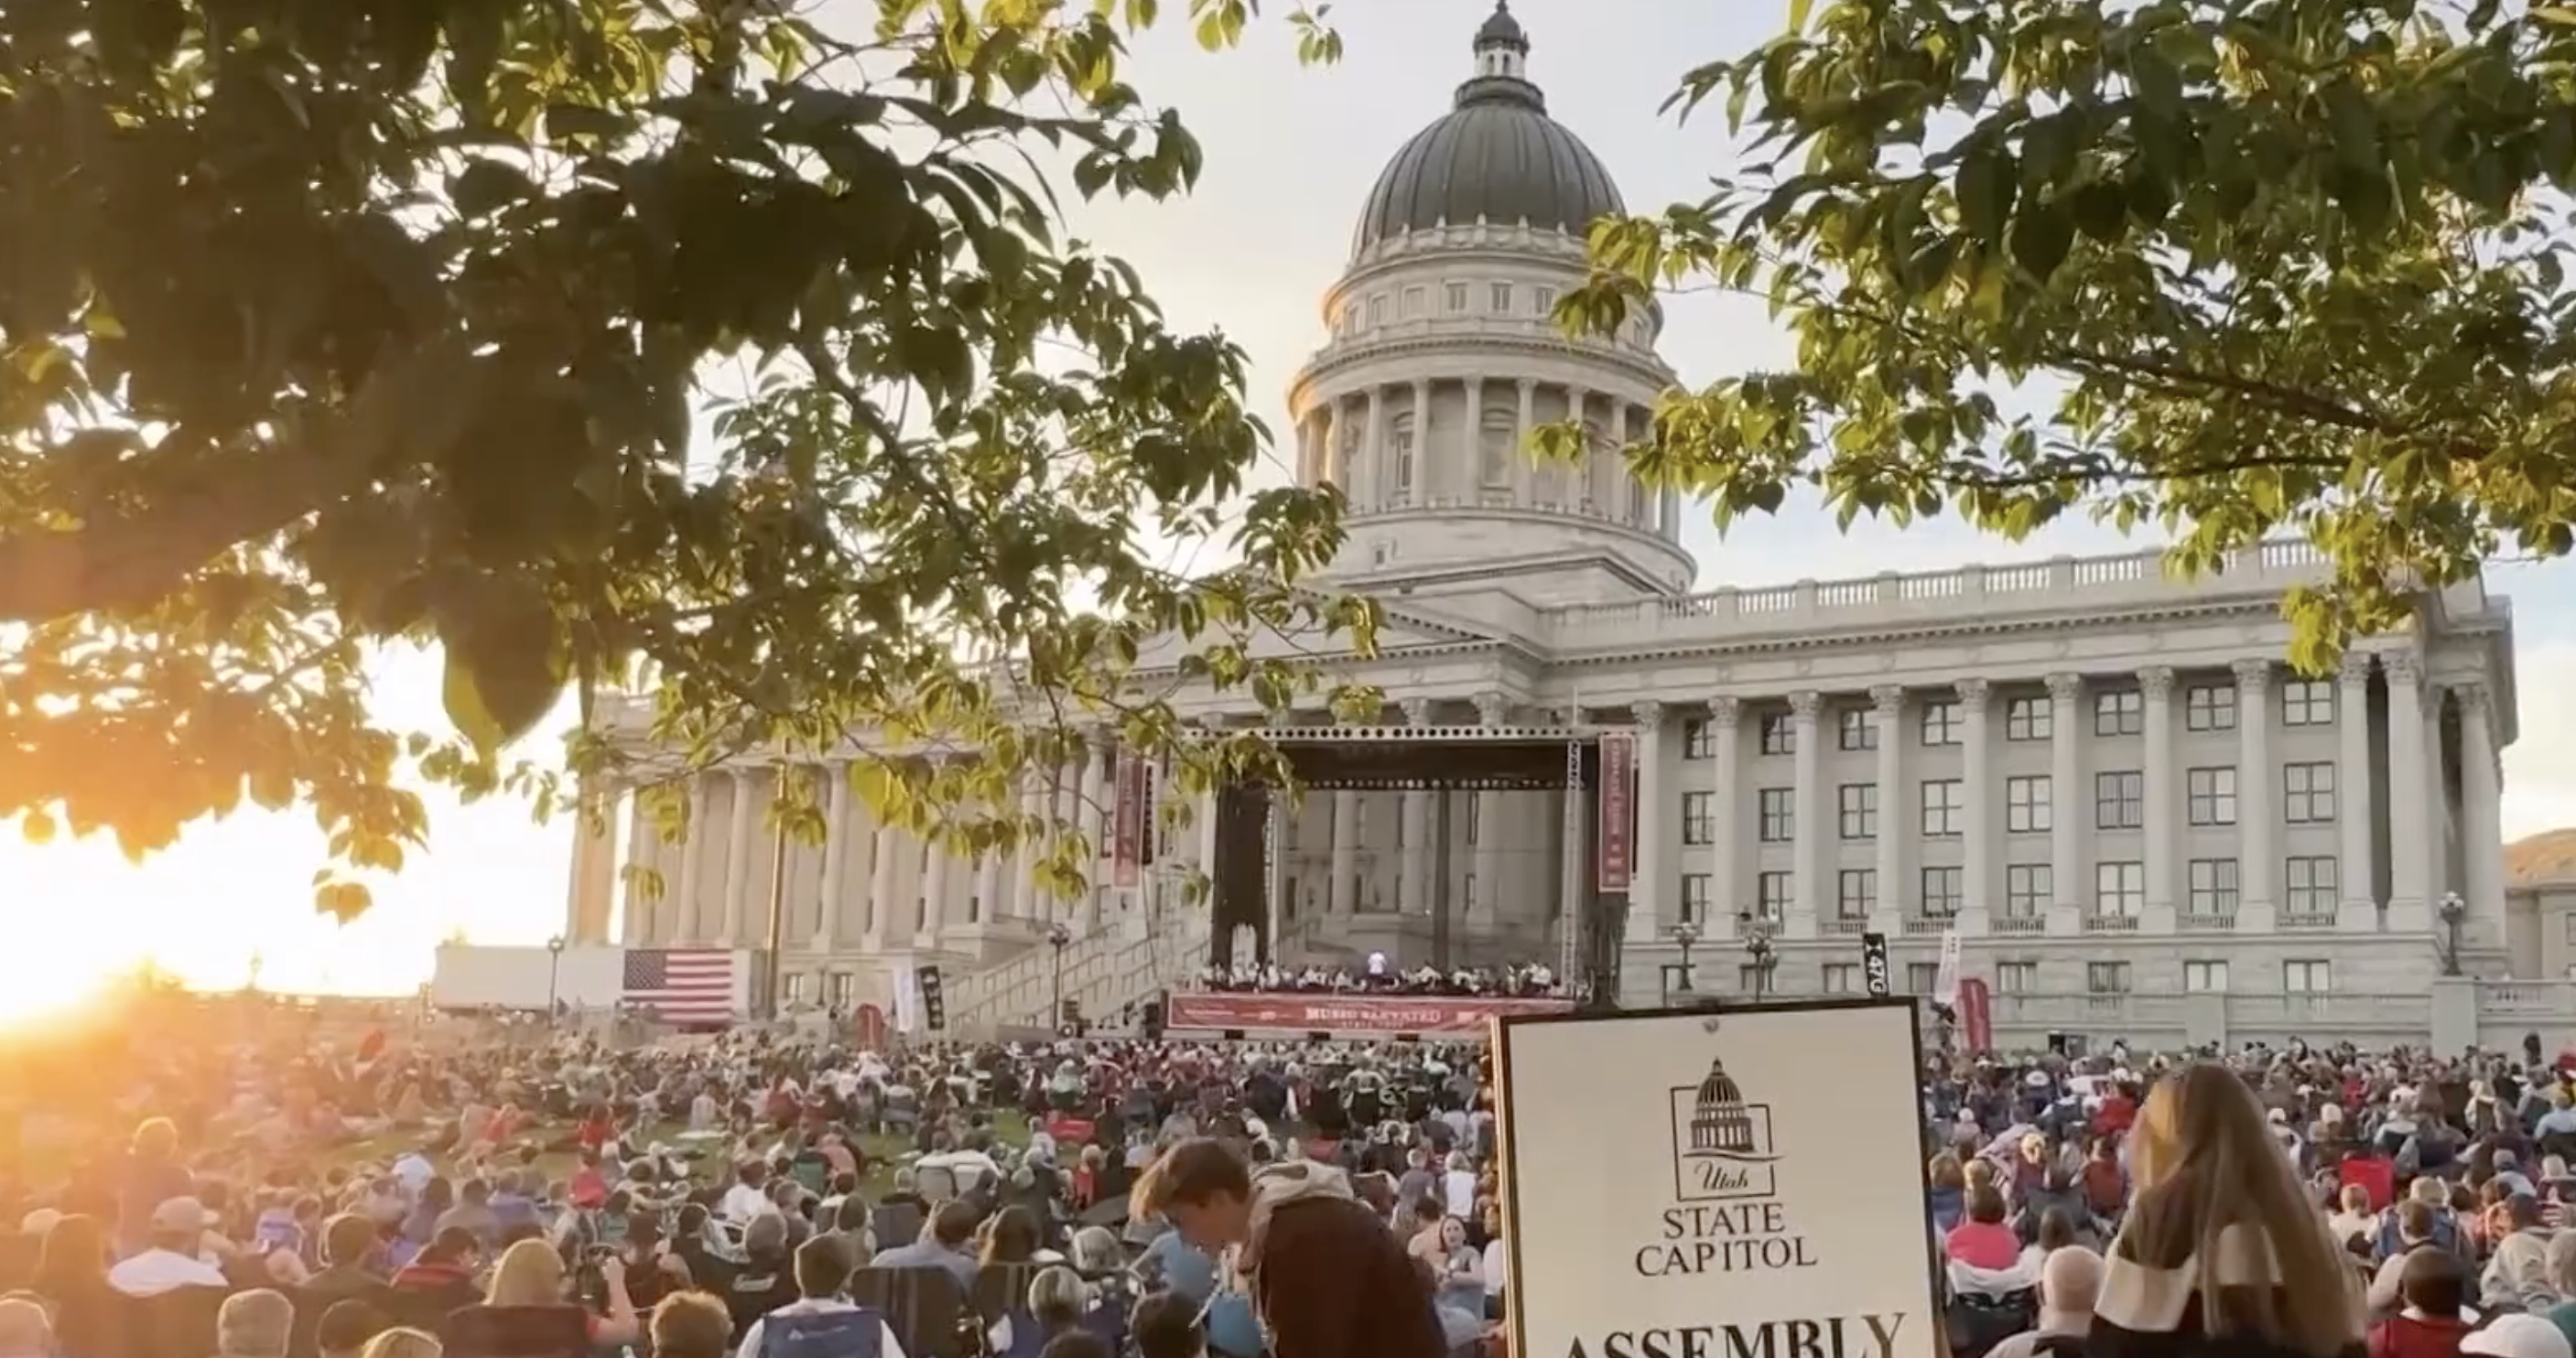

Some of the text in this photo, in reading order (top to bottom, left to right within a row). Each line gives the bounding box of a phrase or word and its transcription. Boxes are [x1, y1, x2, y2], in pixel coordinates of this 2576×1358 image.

[1694, 1160, 1749, 1191] Utah
[1663, 1203, 1785, 1239] STATE
[1636, 1237, 1817, 1277] CAPITOL
